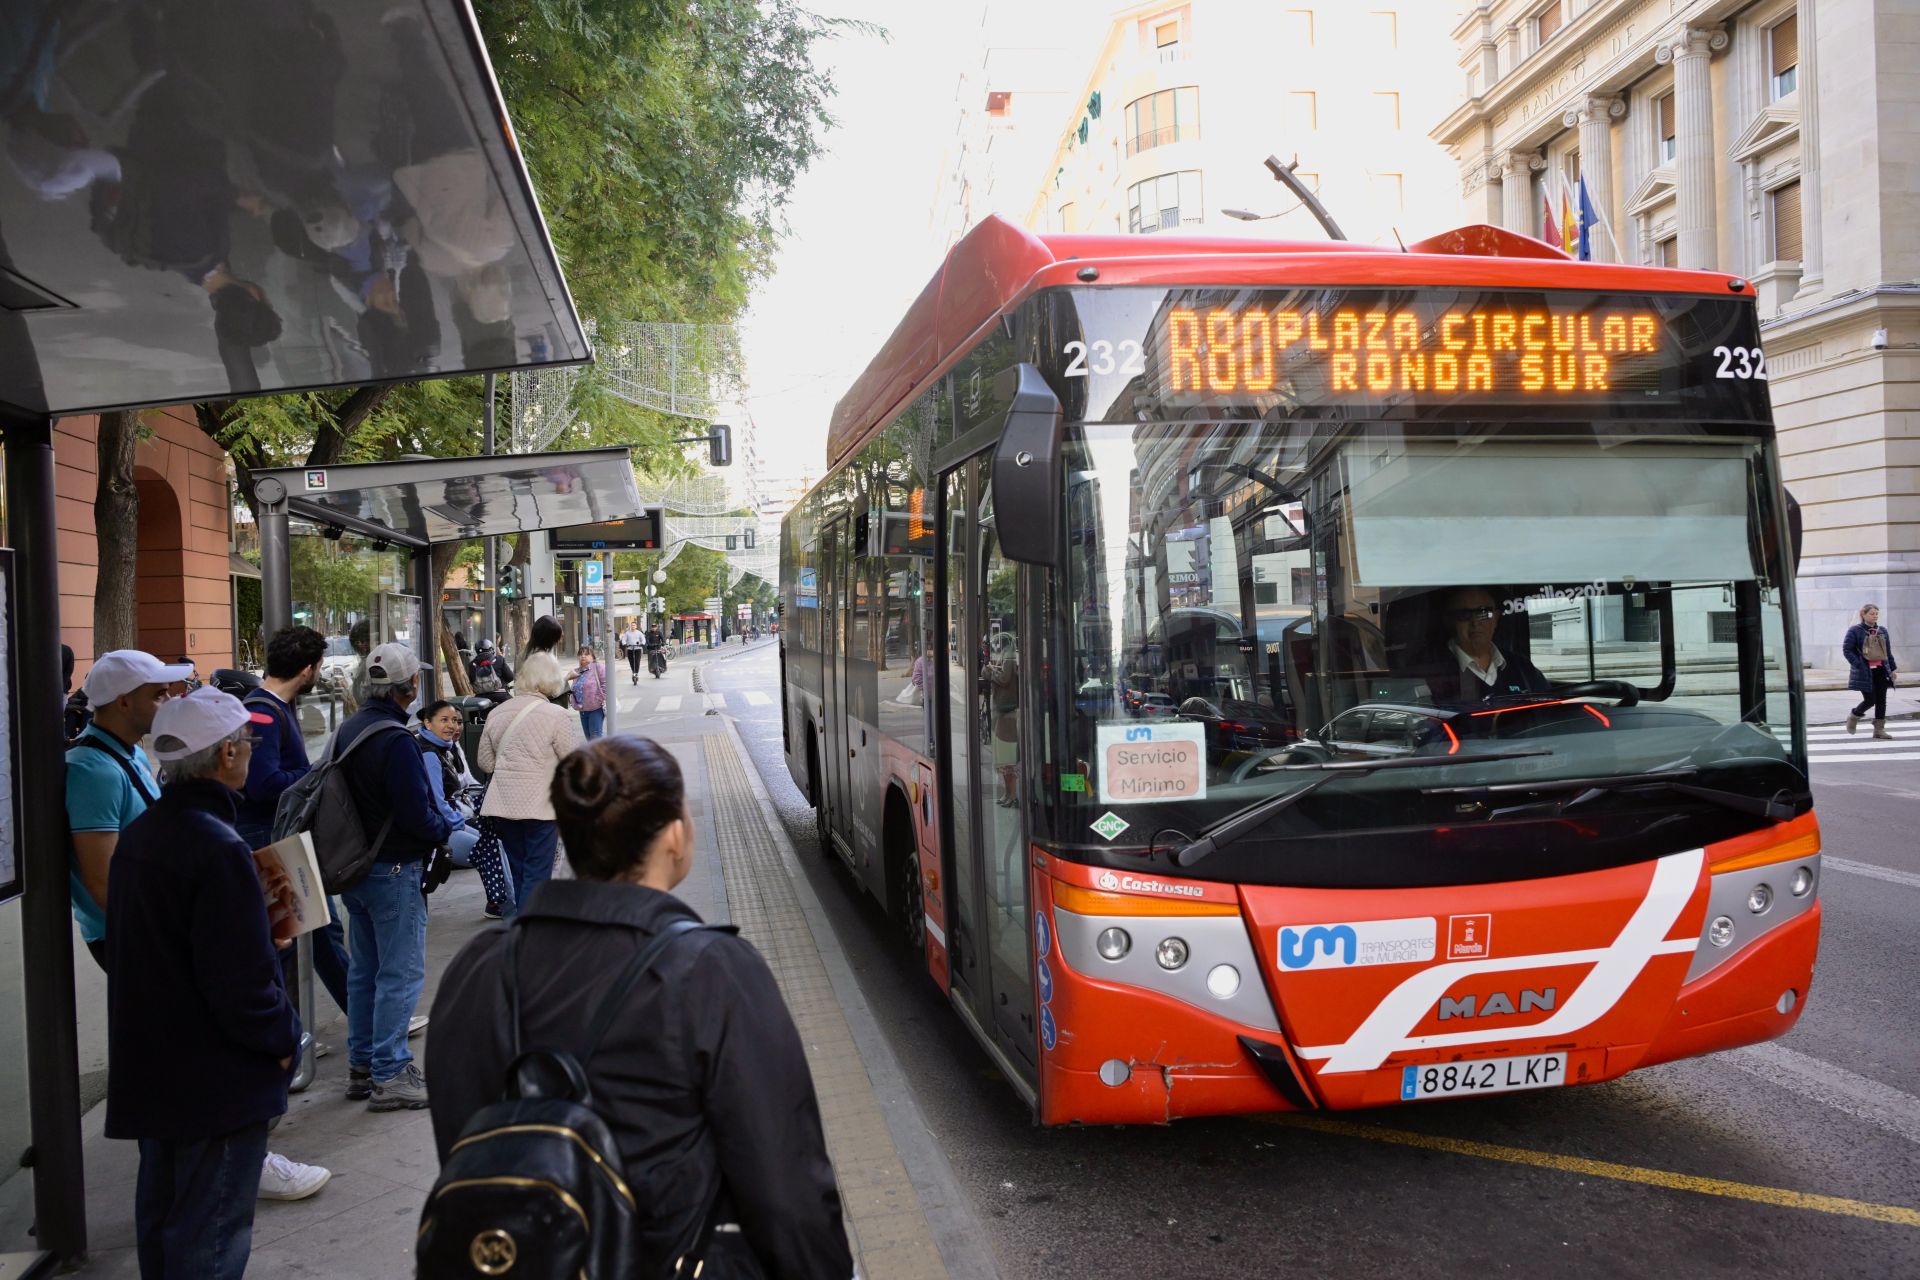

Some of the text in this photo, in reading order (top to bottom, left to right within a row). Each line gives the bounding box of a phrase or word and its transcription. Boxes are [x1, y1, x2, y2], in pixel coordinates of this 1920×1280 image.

[1277, 311, 1656, 352] PLAZA CIRCULAR
[1063, 339, 1146, 377] 232
[1169, 311, 1273, 390] R80
[1332, 353, 1609, 391] RONDA SUR
[1713, 345, 1768, 380] 232
[1117, 748, 1188, 766] Servicio
[1120, 776, 1186, 794] Mínimo
[1097, 817, 1122, 832] GNC
[1121, 876, 1204, 897] Castrosua
[1360, 938, 1435, 953] TRANSPORTES
[1453, 943, 1483, 955] Murcia
[1360, 950, 1418, 965] de MURCIA
[1438, 988, 1557, 1021] MAN
[1422, 1056, 1560, 1094] 8842 LKP
[1405, 1084, 1413, 1094] E
